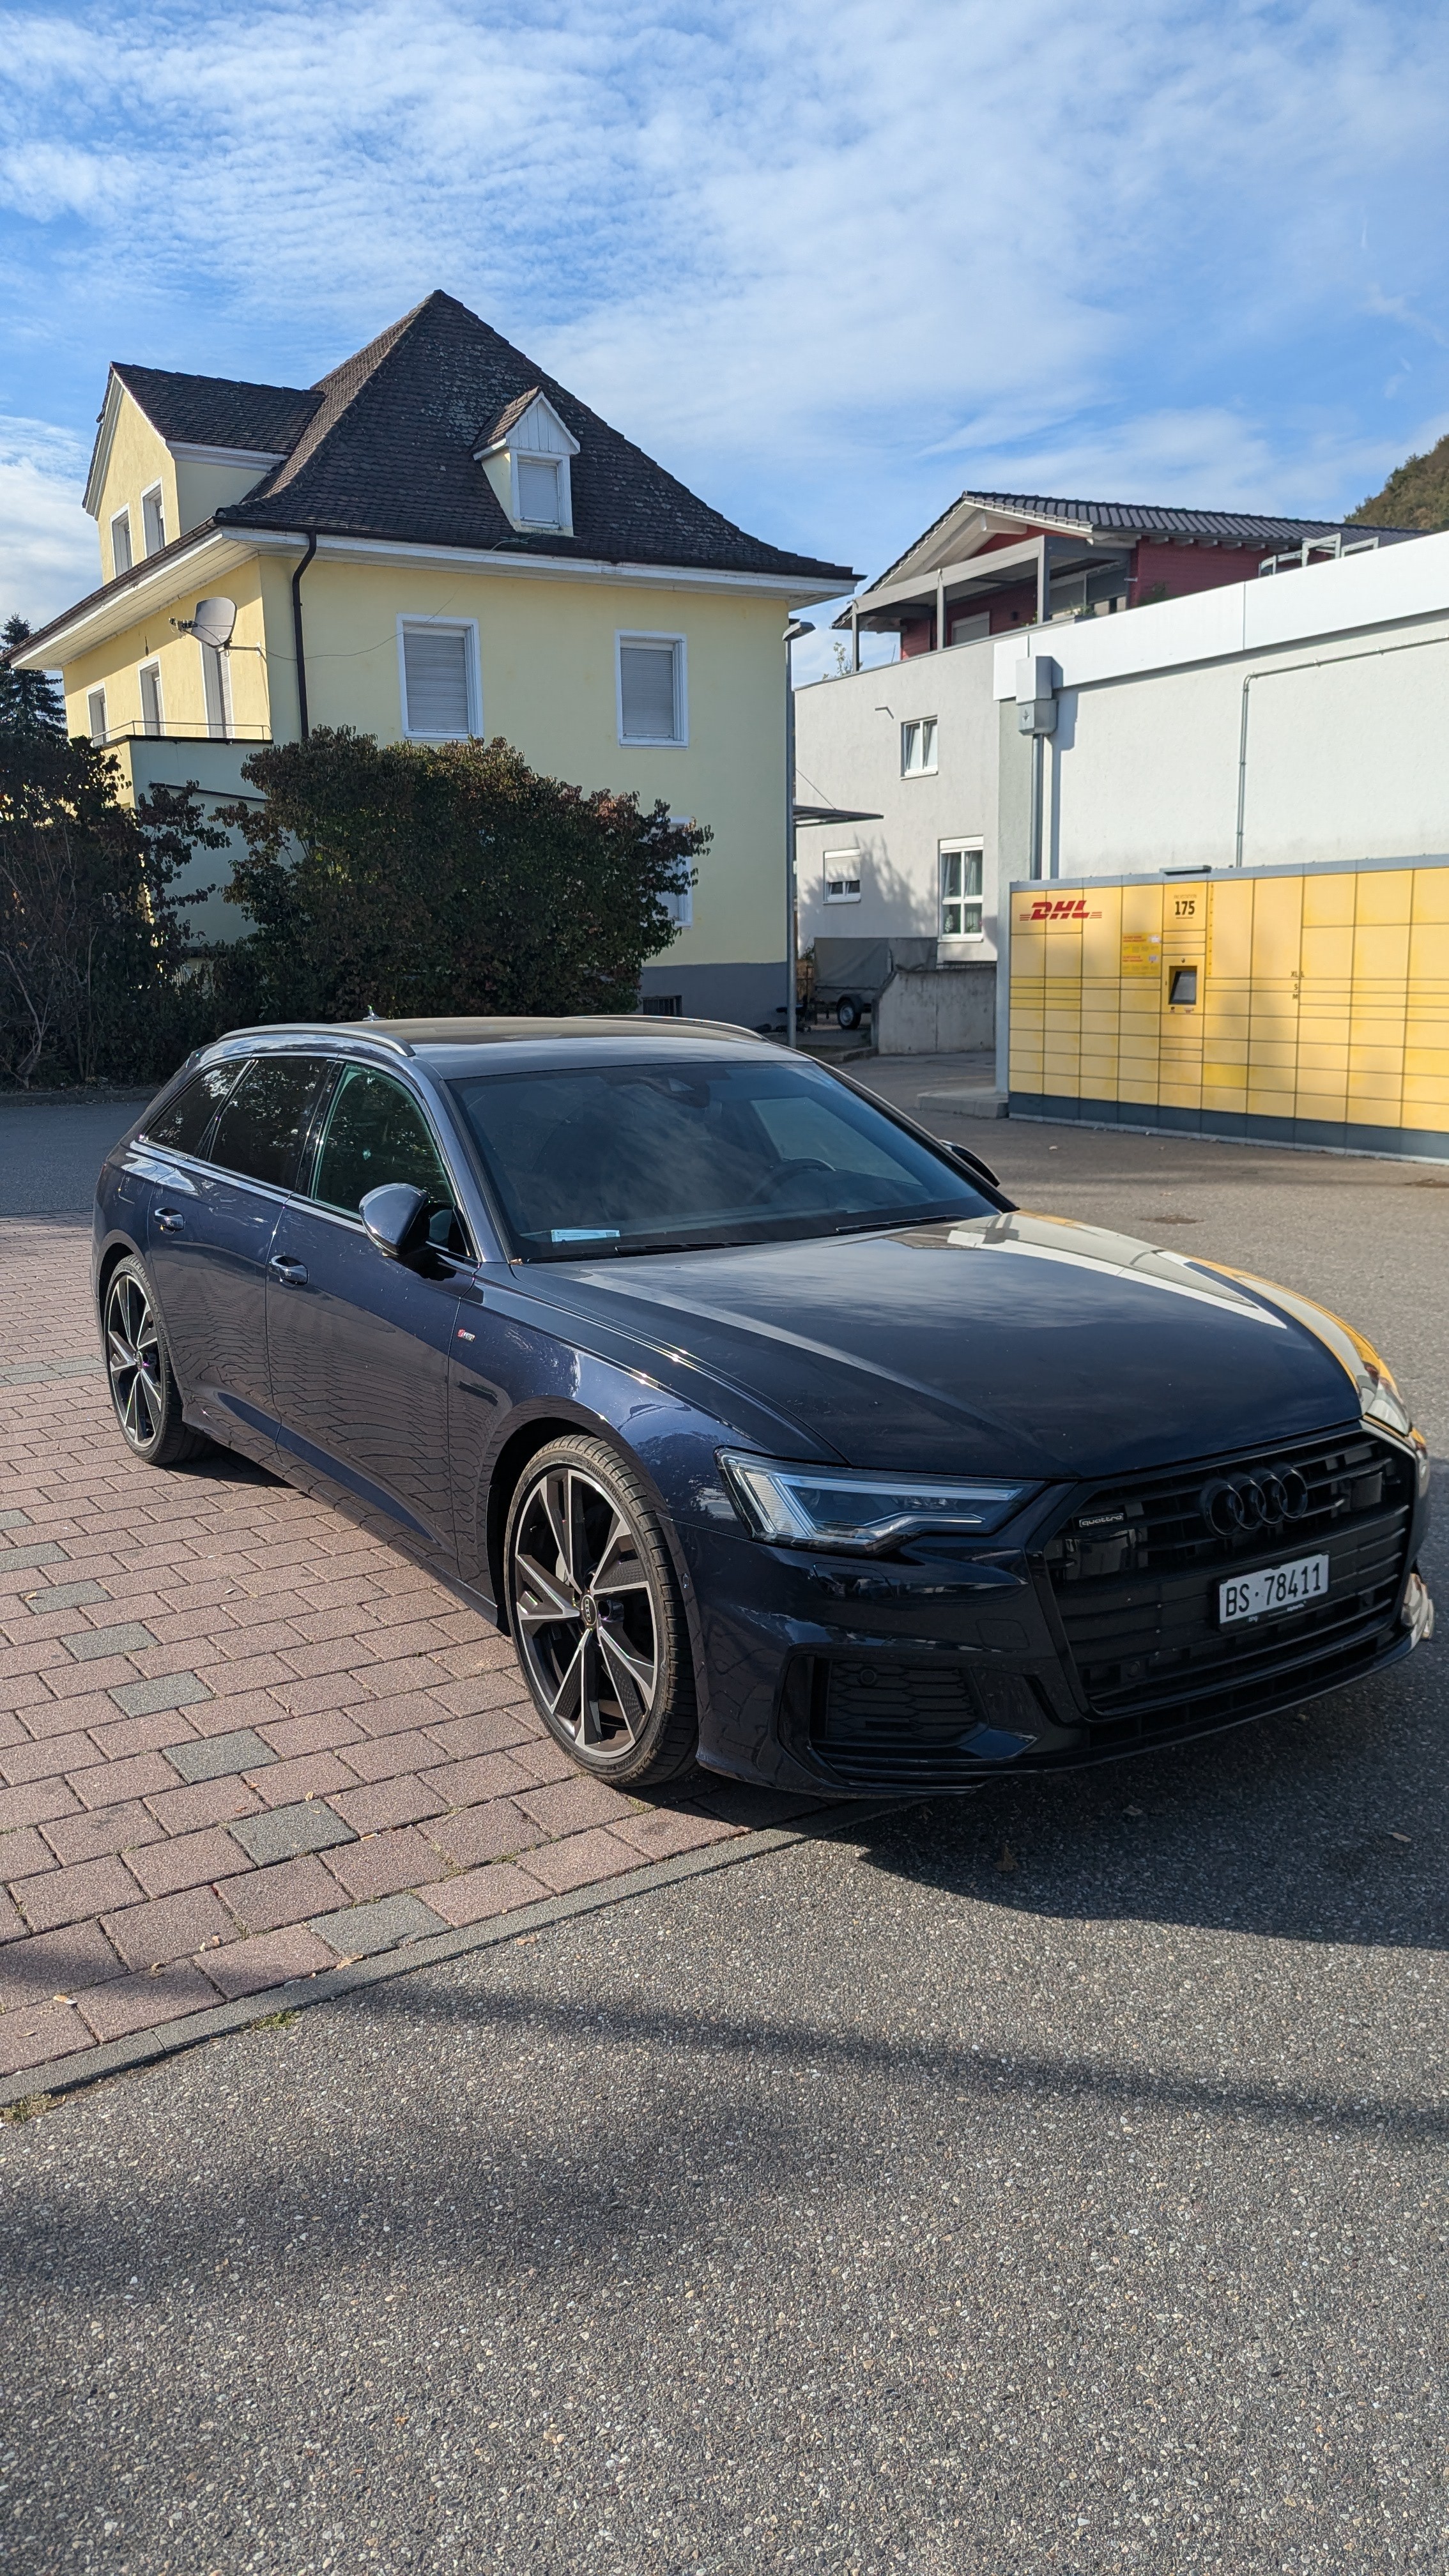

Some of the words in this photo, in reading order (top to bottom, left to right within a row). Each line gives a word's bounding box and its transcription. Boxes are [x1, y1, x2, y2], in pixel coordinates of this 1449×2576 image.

[1029, 900, 1091, 921] DHL
[1175, 900, 1195, 916] 175
[586, 1459, 624, 1505] BRIDGESTONE
[1082, 1515, 1123, 1526] quattro
